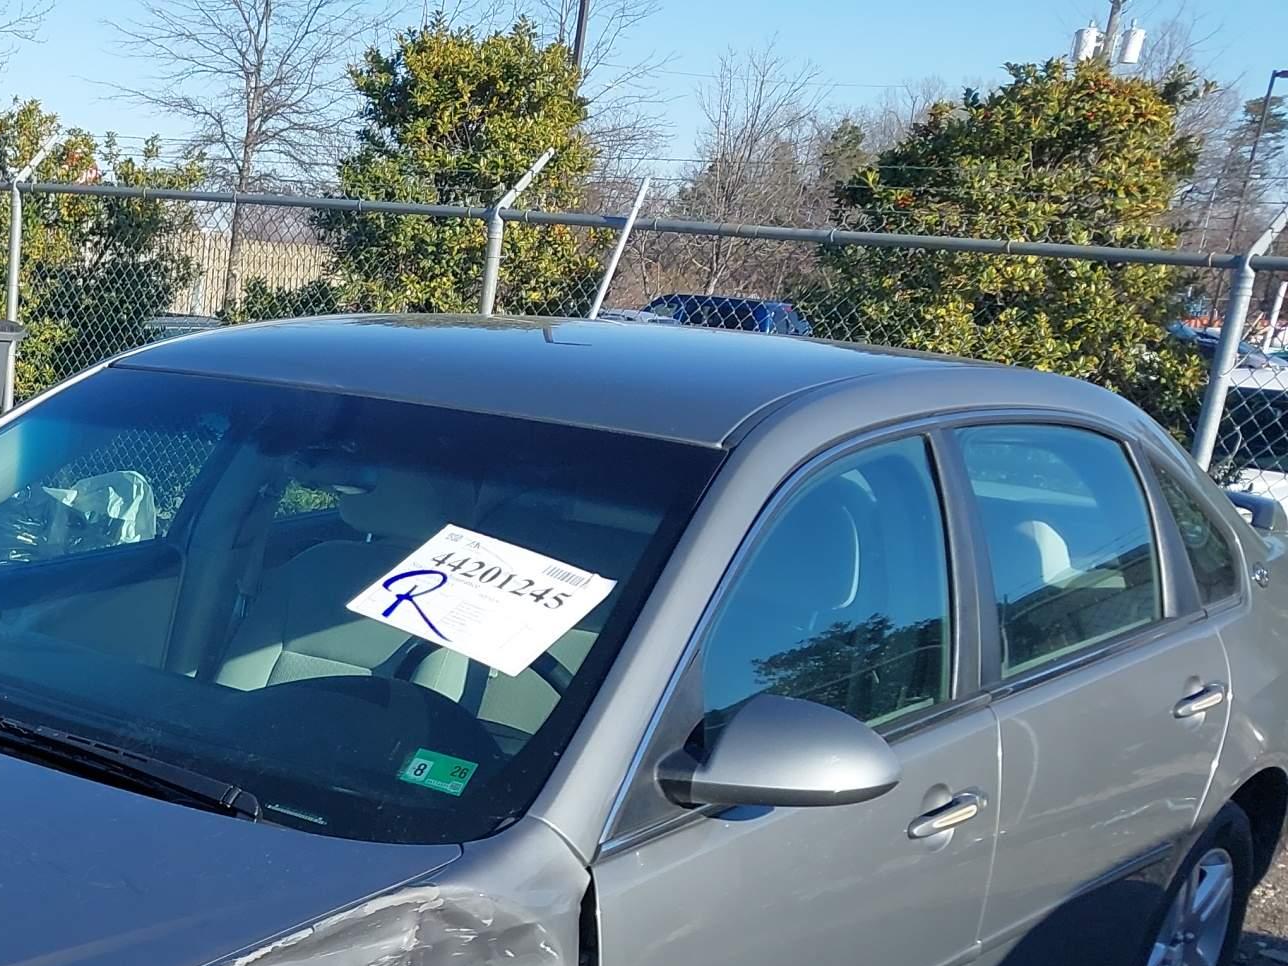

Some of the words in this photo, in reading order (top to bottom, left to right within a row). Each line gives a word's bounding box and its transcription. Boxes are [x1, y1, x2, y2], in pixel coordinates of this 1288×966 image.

[431, 551, 573, 610] 44201245
[413, 762, 428, 777] 8
[449, 765, 469, 779] 26
